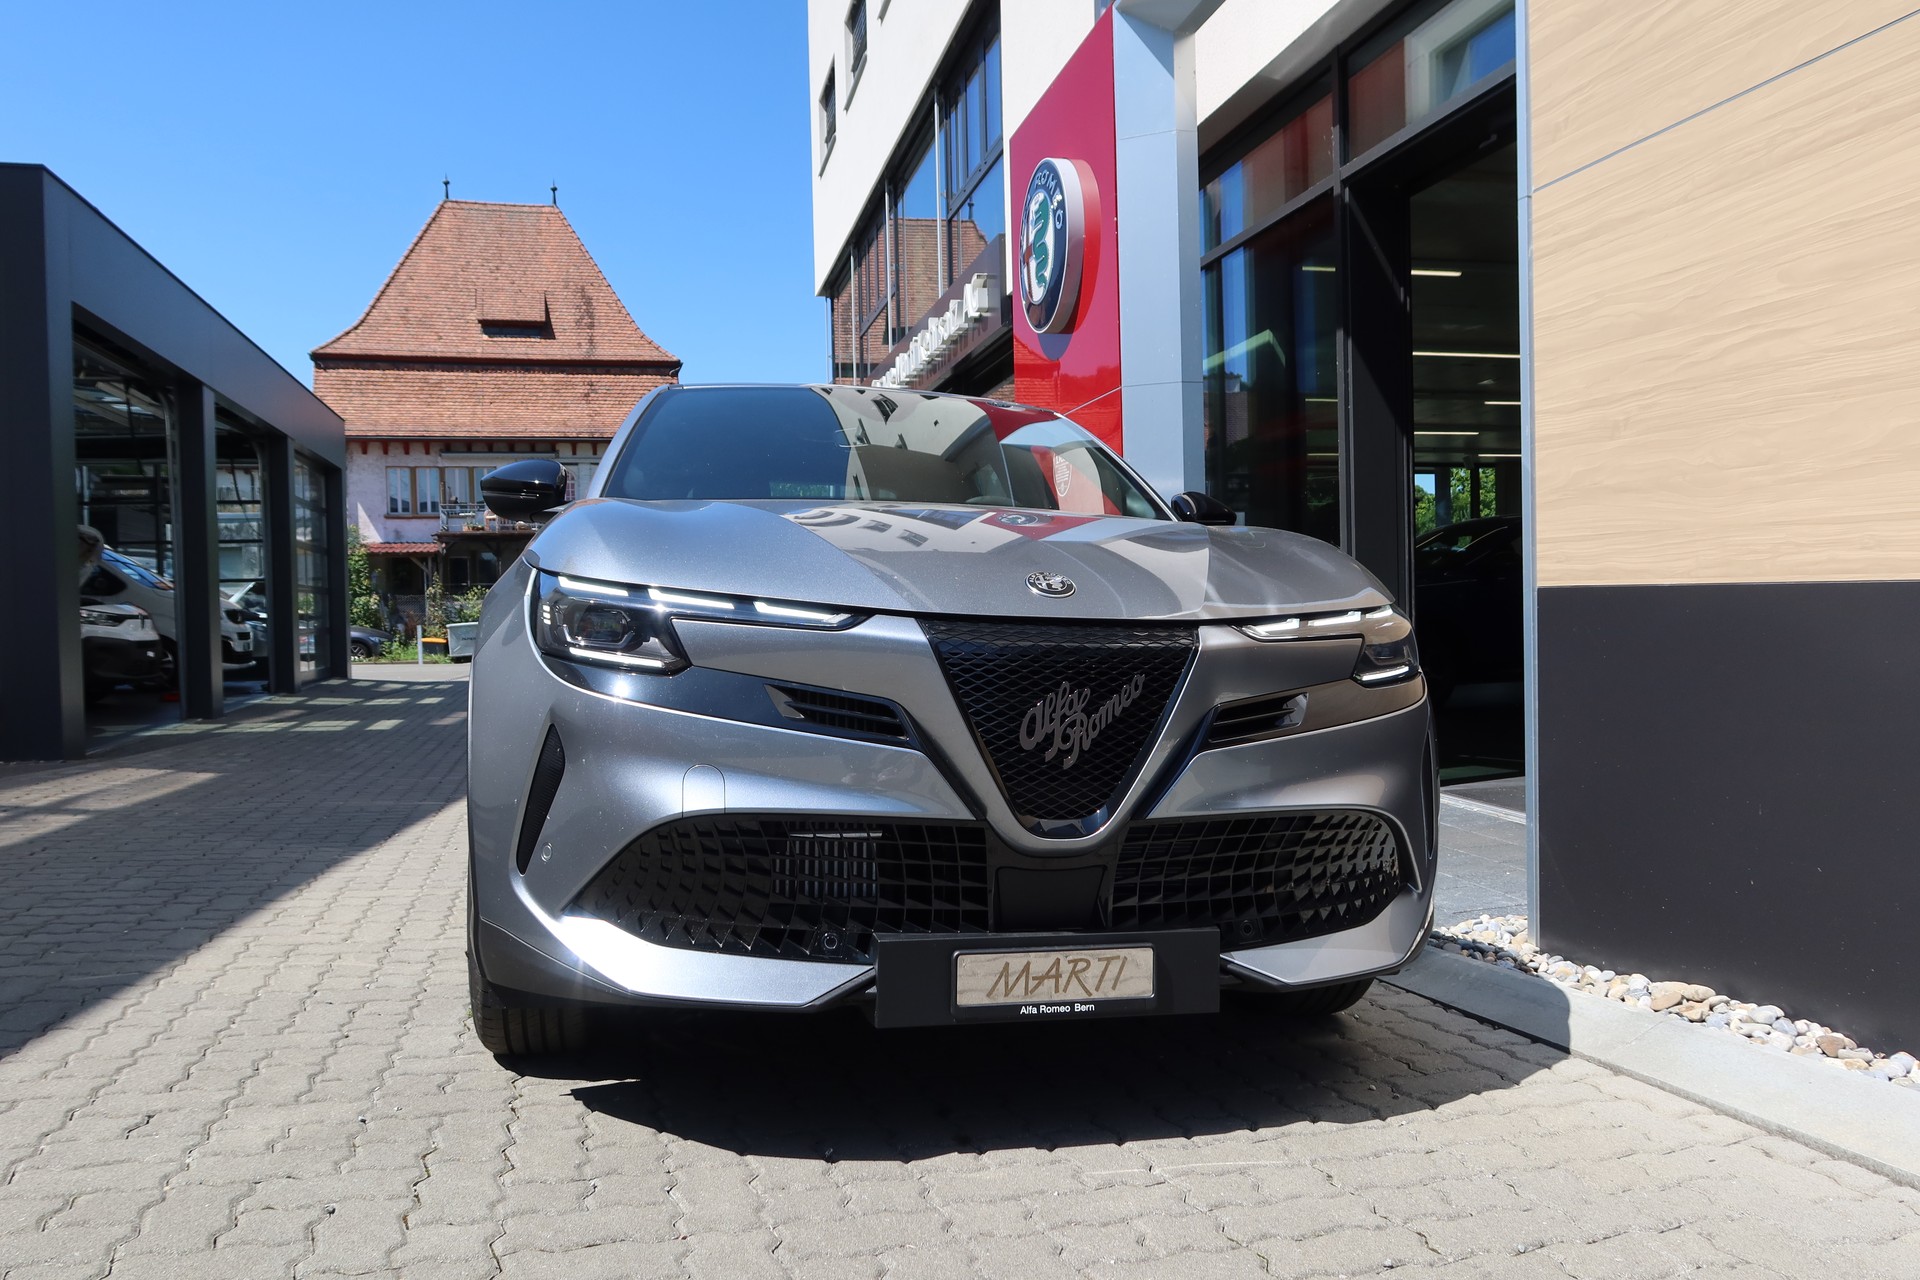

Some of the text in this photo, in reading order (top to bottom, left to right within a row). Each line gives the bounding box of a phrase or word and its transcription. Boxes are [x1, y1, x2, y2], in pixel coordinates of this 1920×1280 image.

[1019, 674, 1145, 769] Alfa Romeo
[986, 956, 1128, 998] MARTI
[1020, 1003, 1095, 1015] Alfa Romeo Bern
